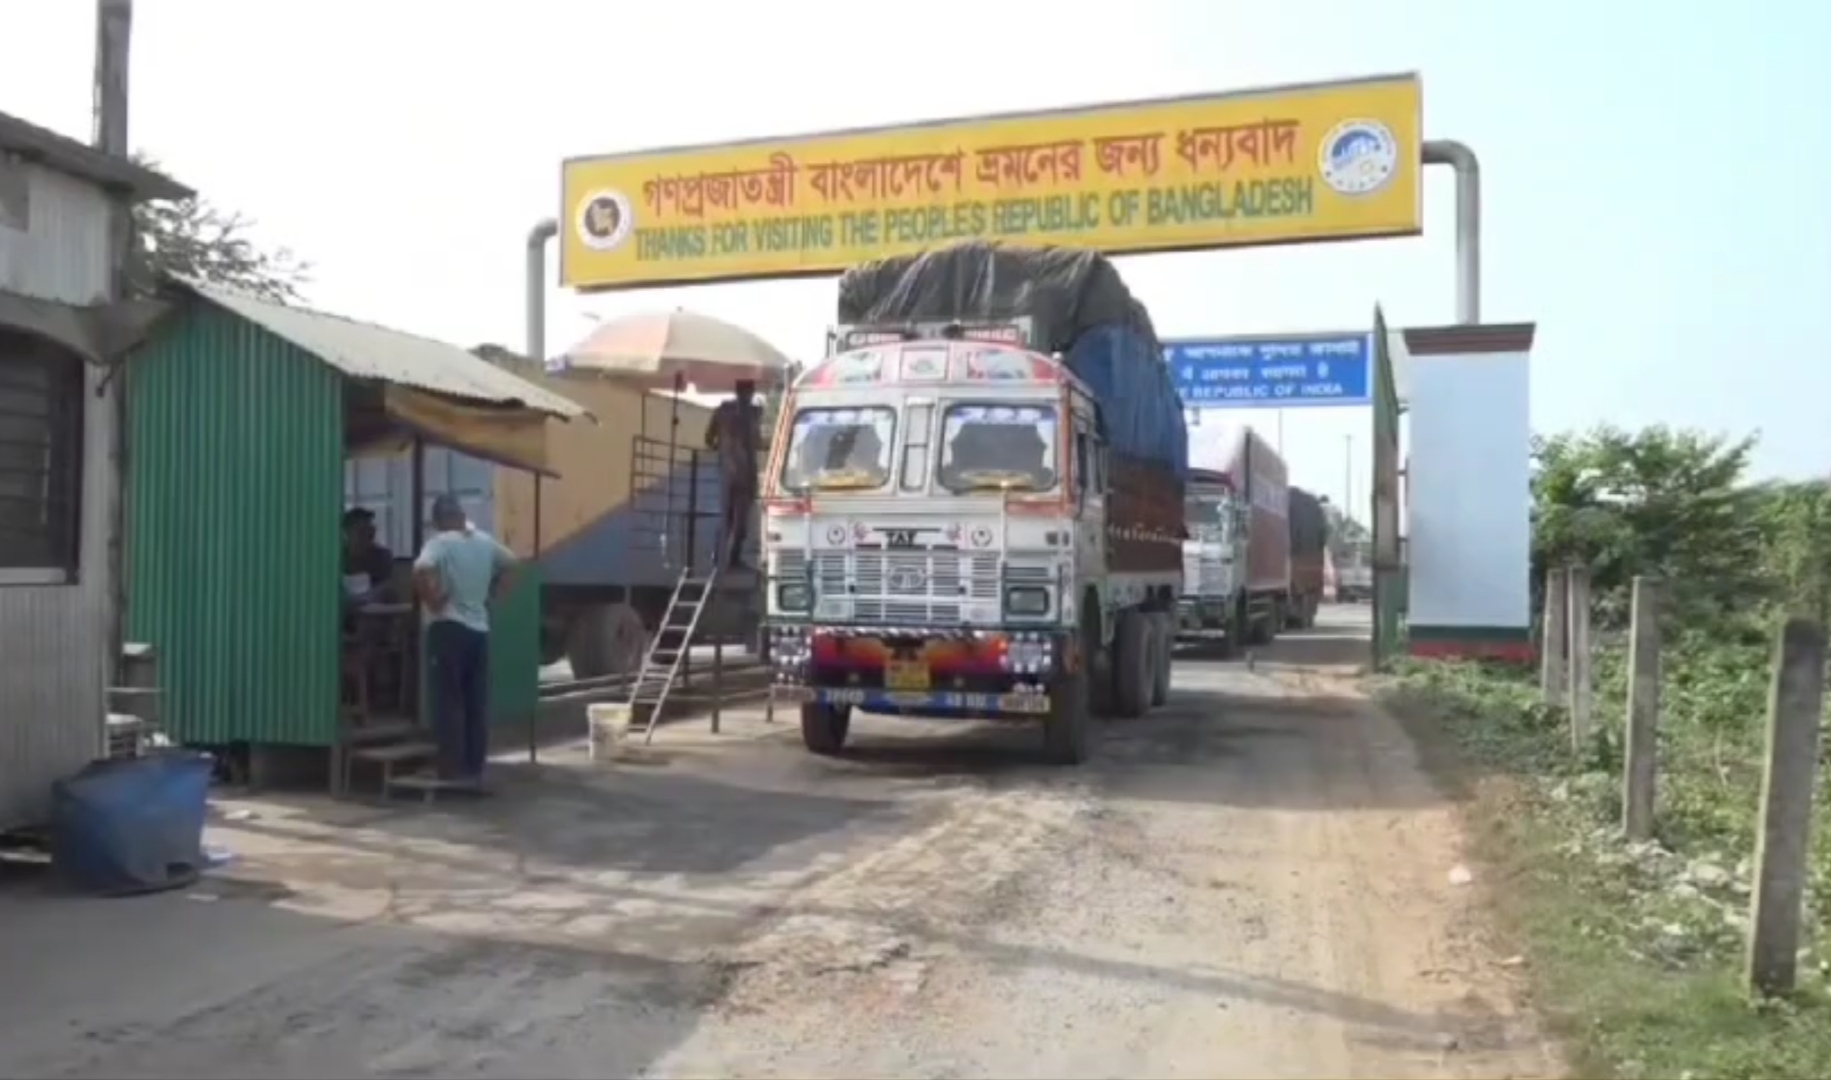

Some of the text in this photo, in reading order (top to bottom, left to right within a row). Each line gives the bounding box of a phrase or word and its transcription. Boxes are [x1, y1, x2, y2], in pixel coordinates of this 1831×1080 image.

[807, 146, 966, 202] বাংলাদেশে
[1093, 132, 1165, 176] জন্য
[1176, 117, 1300, 172] ধন্যবাদ
[635, 228, 706, 261] THANKS
[712, 221, 749, 255] FOR
[753, 215, 832, 251] VISITING
[839, 210, 878, 245] THE
[993, 192, 1100, 235] REPUBLIC
[1109, 188, 1139, 226] OF
[1147, 176, 1313, 224] BANGLADESH
[1193, 386, 1268, 397] REPUBLIC
[1274, 385, 1293, 395] OF
[1301, 383, 1342, 394] INDIA
